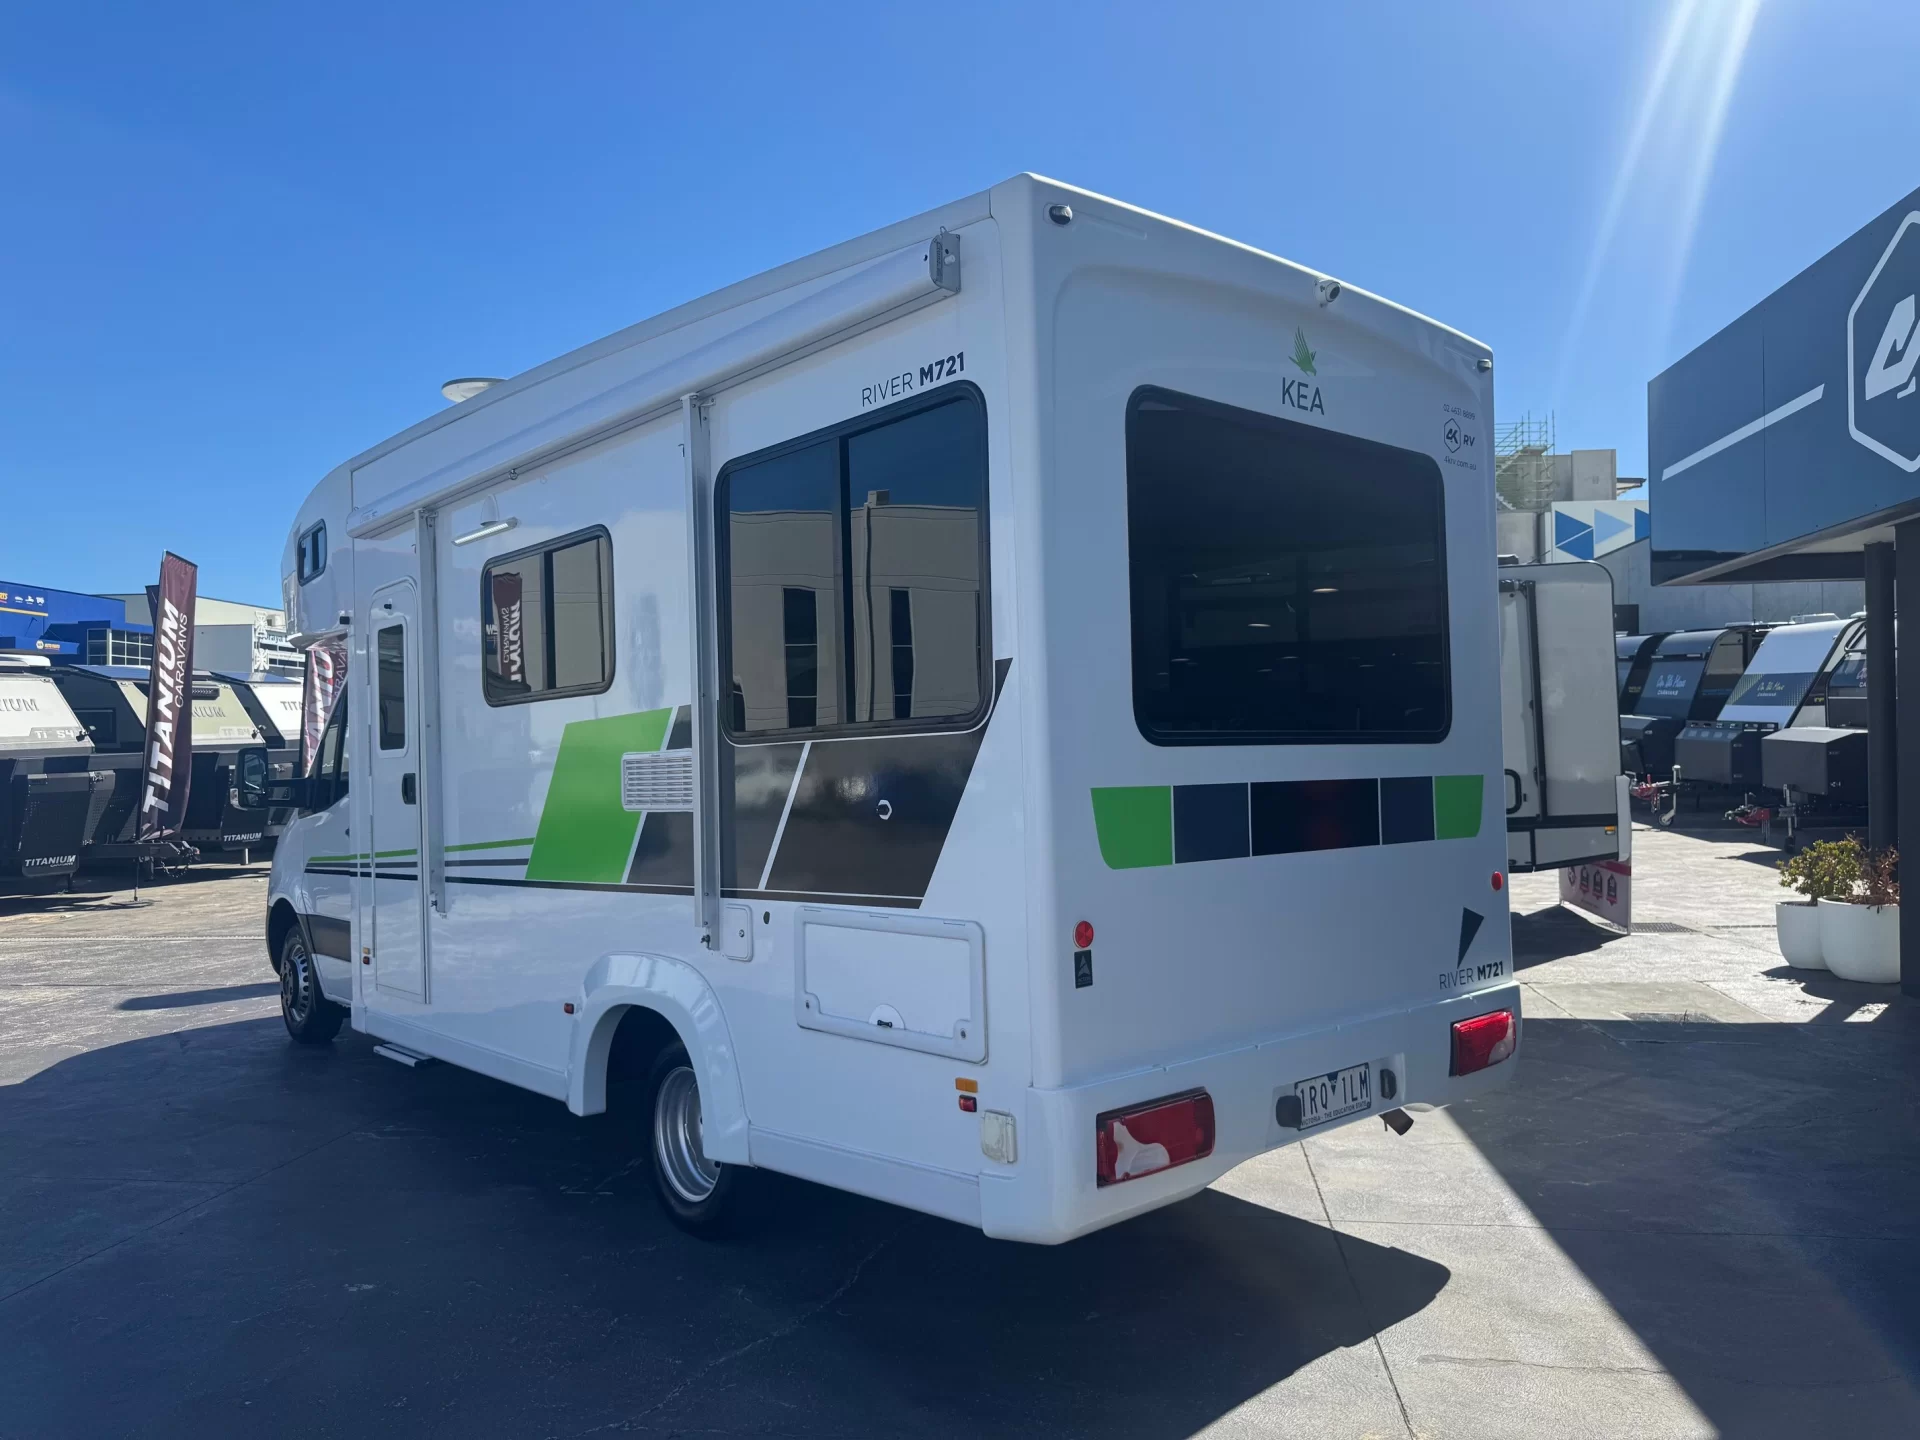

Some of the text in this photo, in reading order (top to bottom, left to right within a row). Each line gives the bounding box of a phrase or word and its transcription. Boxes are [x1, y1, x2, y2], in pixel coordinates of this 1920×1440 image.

[862, 351, 965, 407] RIVER M721
[1281, 376, 1325, 416] KEA
[1463, 434, 1475, 447] RV
[174, 612, 188, 709] CARAVANS
[143, 597, 180, 813] TITANIUM
[223, 831, 263, 842] TITANIUM
[25, 855, 77, 867] TITANIUM
[1439, 960, 1503, 990] RIVER M721
[1300, 1070, 1369, 1118] 1RQ 1LM
[1324, 1111, 1332, 1119] THE
[1333, 1104, 1355, 1117] EDUCATION
